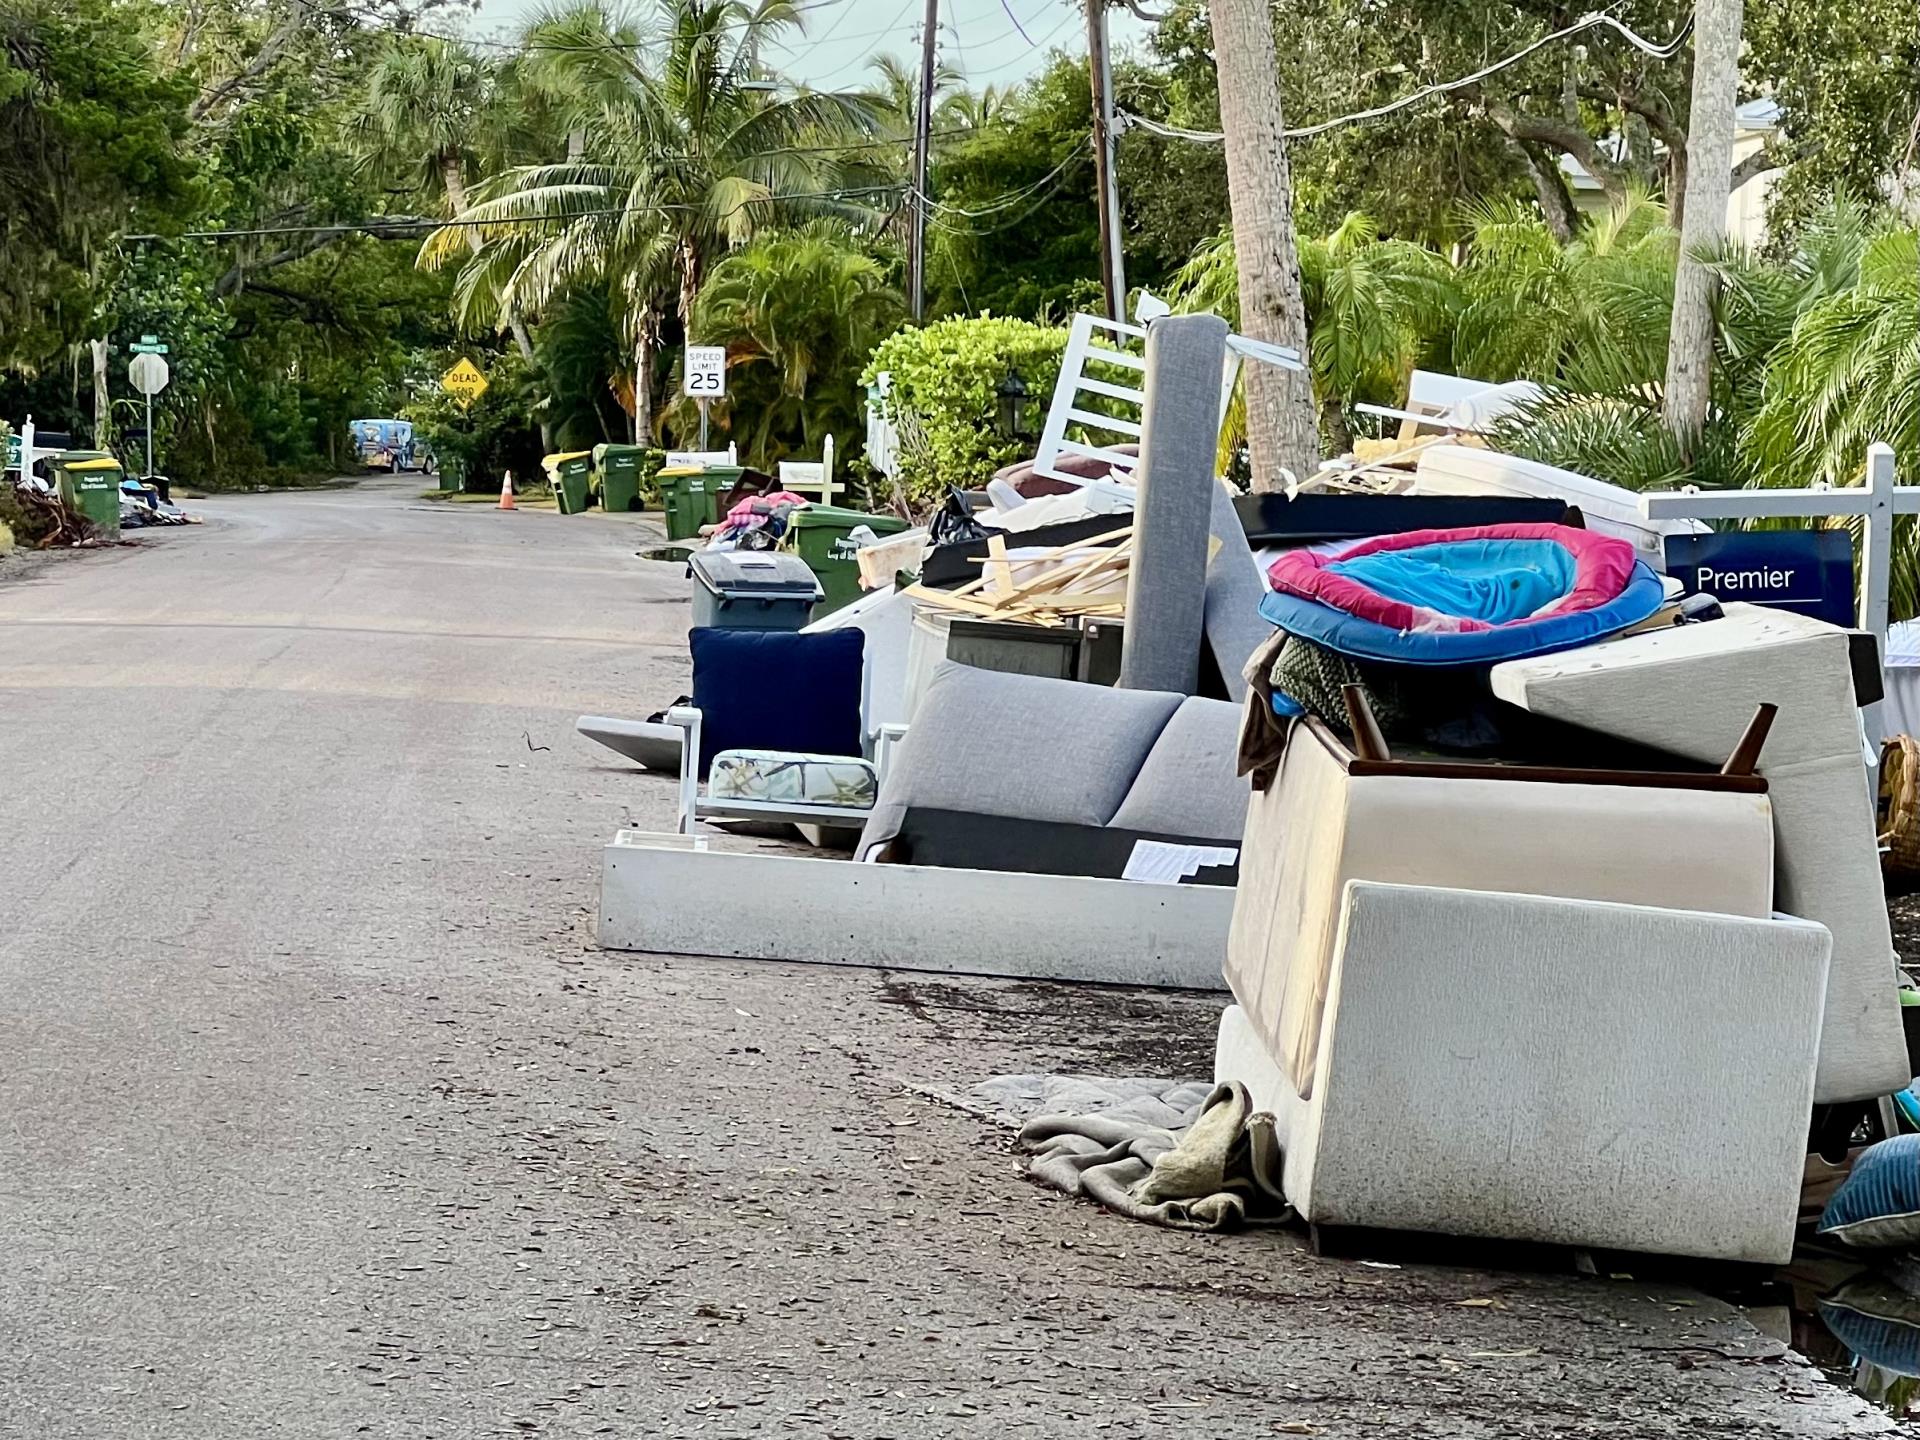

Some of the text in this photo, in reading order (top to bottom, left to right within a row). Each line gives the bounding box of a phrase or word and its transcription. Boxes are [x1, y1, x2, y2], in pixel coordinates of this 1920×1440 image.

[689, 353, 721, 361] SPEED
[452, 373, 478, 383] DEAD
[690, 373, 720, 390] 25
[1697, 565, 1795, 591] Premier
